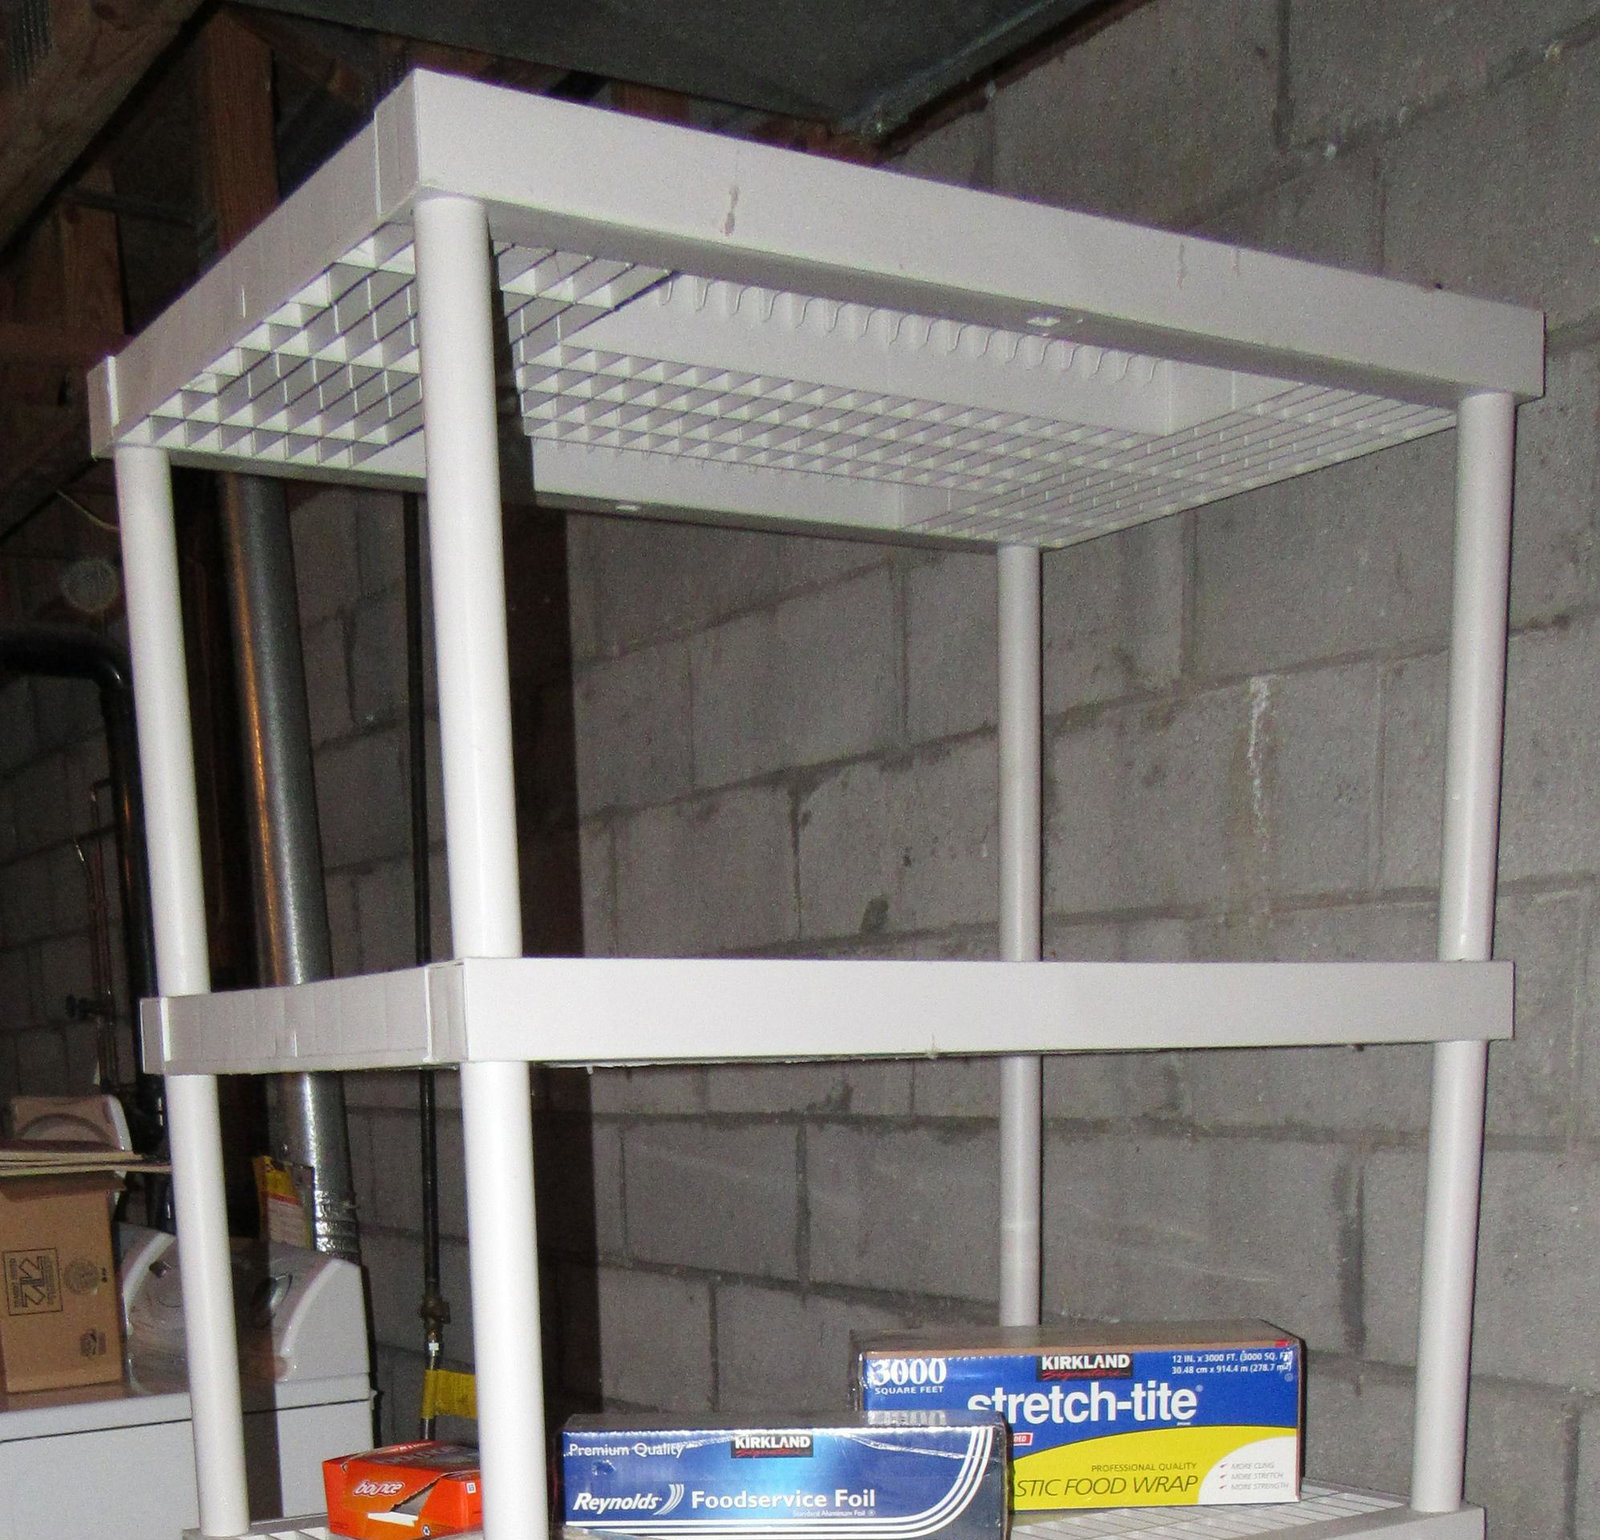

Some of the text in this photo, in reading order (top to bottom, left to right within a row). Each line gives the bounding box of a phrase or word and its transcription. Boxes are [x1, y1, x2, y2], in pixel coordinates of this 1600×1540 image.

[1041, 1354, 1131, 1370] KIRKLAND
[1172, 1355, 1182, 1363] 12
[1204, 1353, 1224, 1362] 3000
[1226, 1353, 1238, 1361] FT.
[1240, 1352, 1262, 1362] (3000
[1264, 1352, 1278, 1361] SQ.
[868, 1358, 947, 1386] 3000
[1171, 1365, 1194, 1374] 30.48
[1216, 1364, 1239, 1373] 914.4
[1249, 1363, 1275, 1373] (278.7
[874, 1386, 916, 1395] SQUARE
[735, 1435, 811, 1449] KIRKLAND
[569, 1442, 684, 1459] Premium Quality
[1091, 1462, 1197, 1473] PROFESSIONAL QUALITY
[1015, 1475, 1199, 1497] STIC FOOD WRAP
[572, 1492, 660, 1515] Reynolds
[691, 1489, 876, 1510] Foodservice Foil
